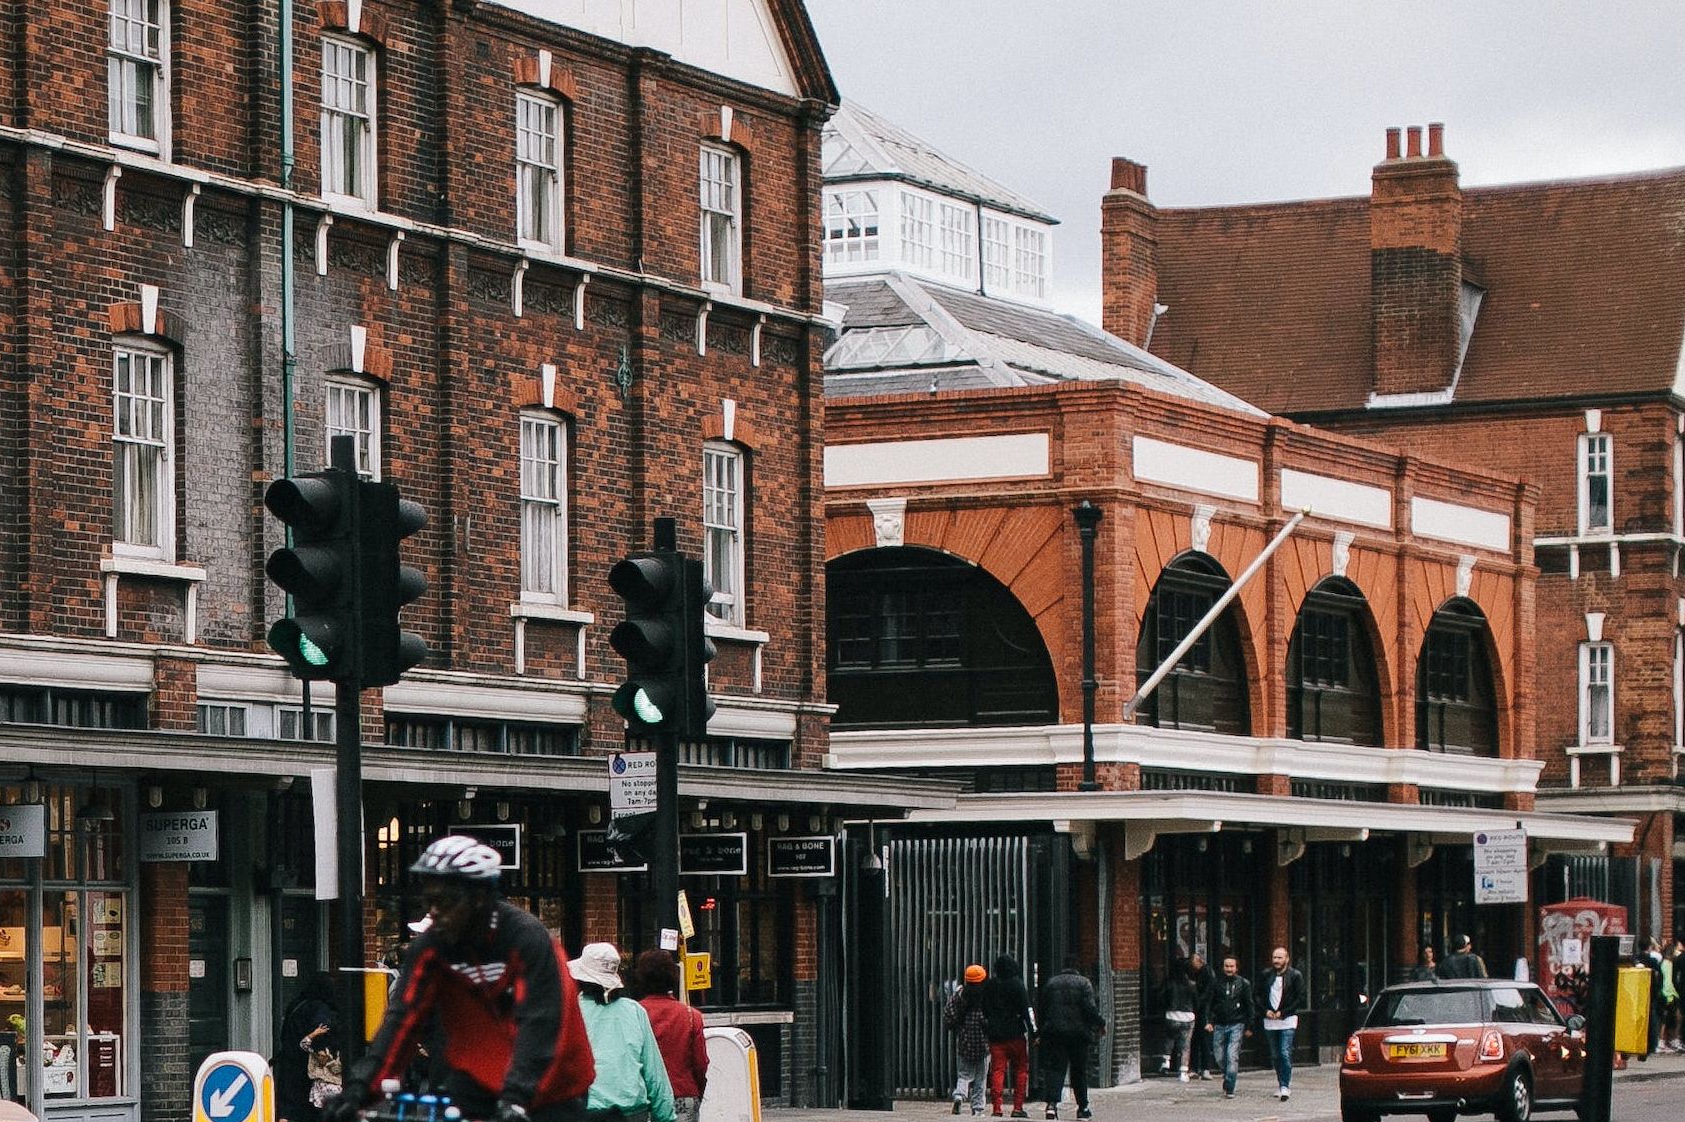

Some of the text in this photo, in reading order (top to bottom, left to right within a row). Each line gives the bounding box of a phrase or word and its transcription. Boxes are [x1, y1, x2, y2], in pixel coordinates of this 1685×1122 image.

[628, 761, 643, 769] RED
[146, 817, 209, 832] SUPERGA
[166, 836, 181, 845] 105
[802, 842, 825, 851] BONE
